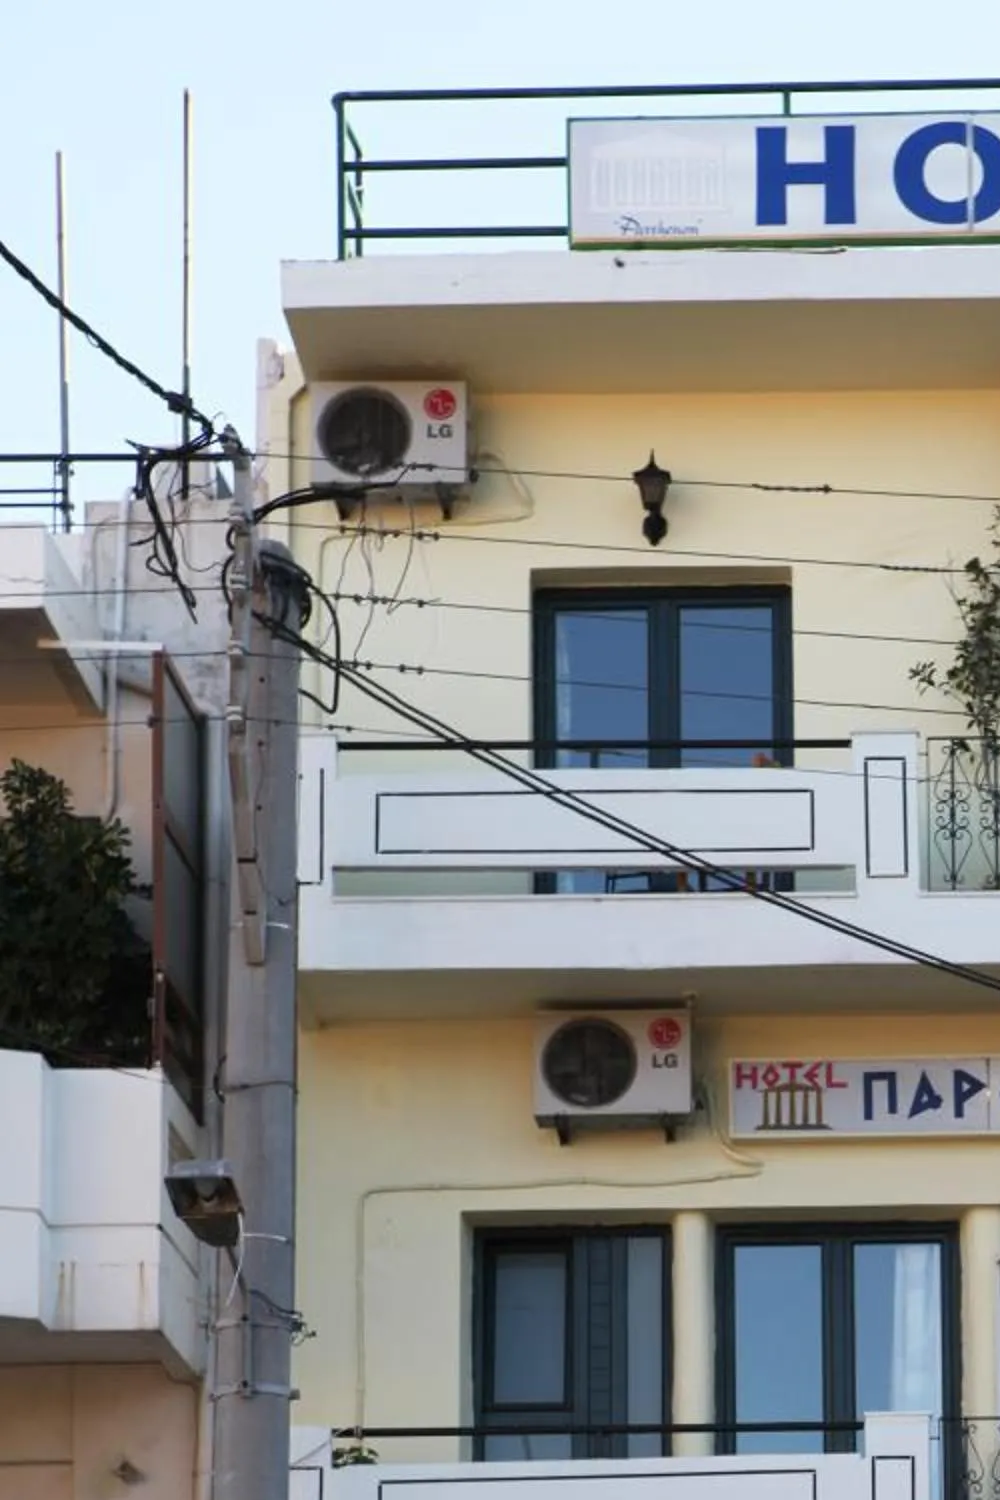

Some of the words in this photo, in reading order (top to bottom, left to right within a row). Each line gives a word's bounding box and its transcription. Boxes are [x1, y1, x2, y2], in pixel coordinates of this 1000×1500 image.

[426, 424, 454, 439] LG
[651, 1054, 678, 1069] LG
[735, 1060, 848, 1090] HOTEL
